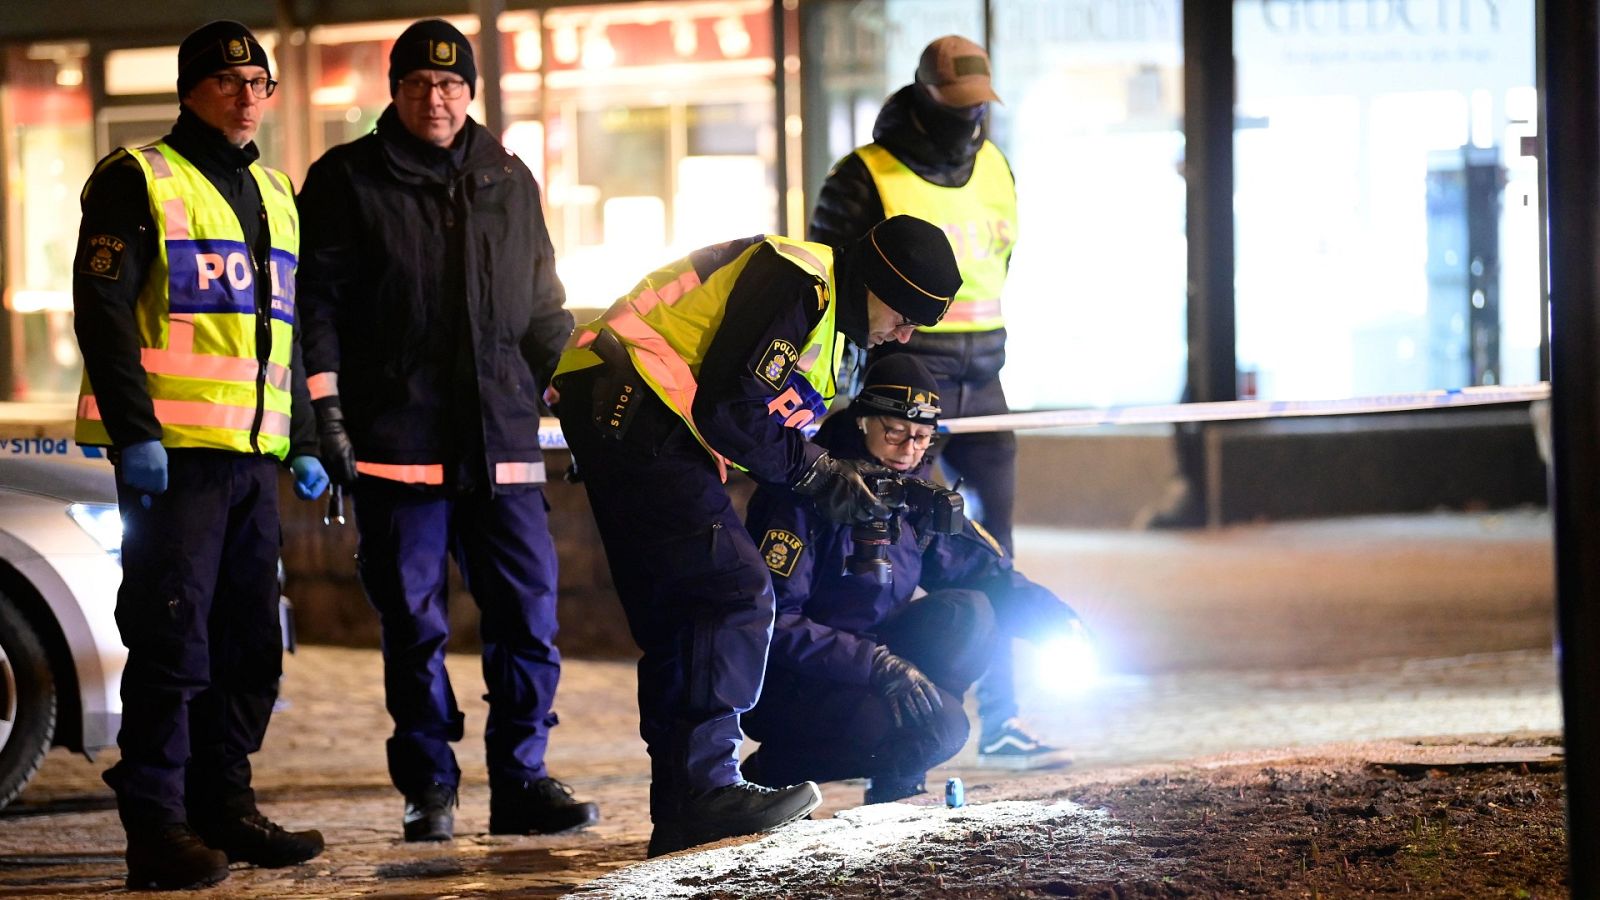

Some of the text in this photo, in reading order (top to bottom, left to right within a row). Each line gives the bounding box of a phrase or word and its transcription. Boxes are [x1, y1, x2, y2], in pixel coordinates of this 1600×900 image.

[90, 237, 124, 252] POLIS
[774, 341, 797, 362] POLIS
[611, 385, 633, 427] POLIS
[11, 437, 68, 455] POLIS
[770, 531, 801, 550] POLIS
